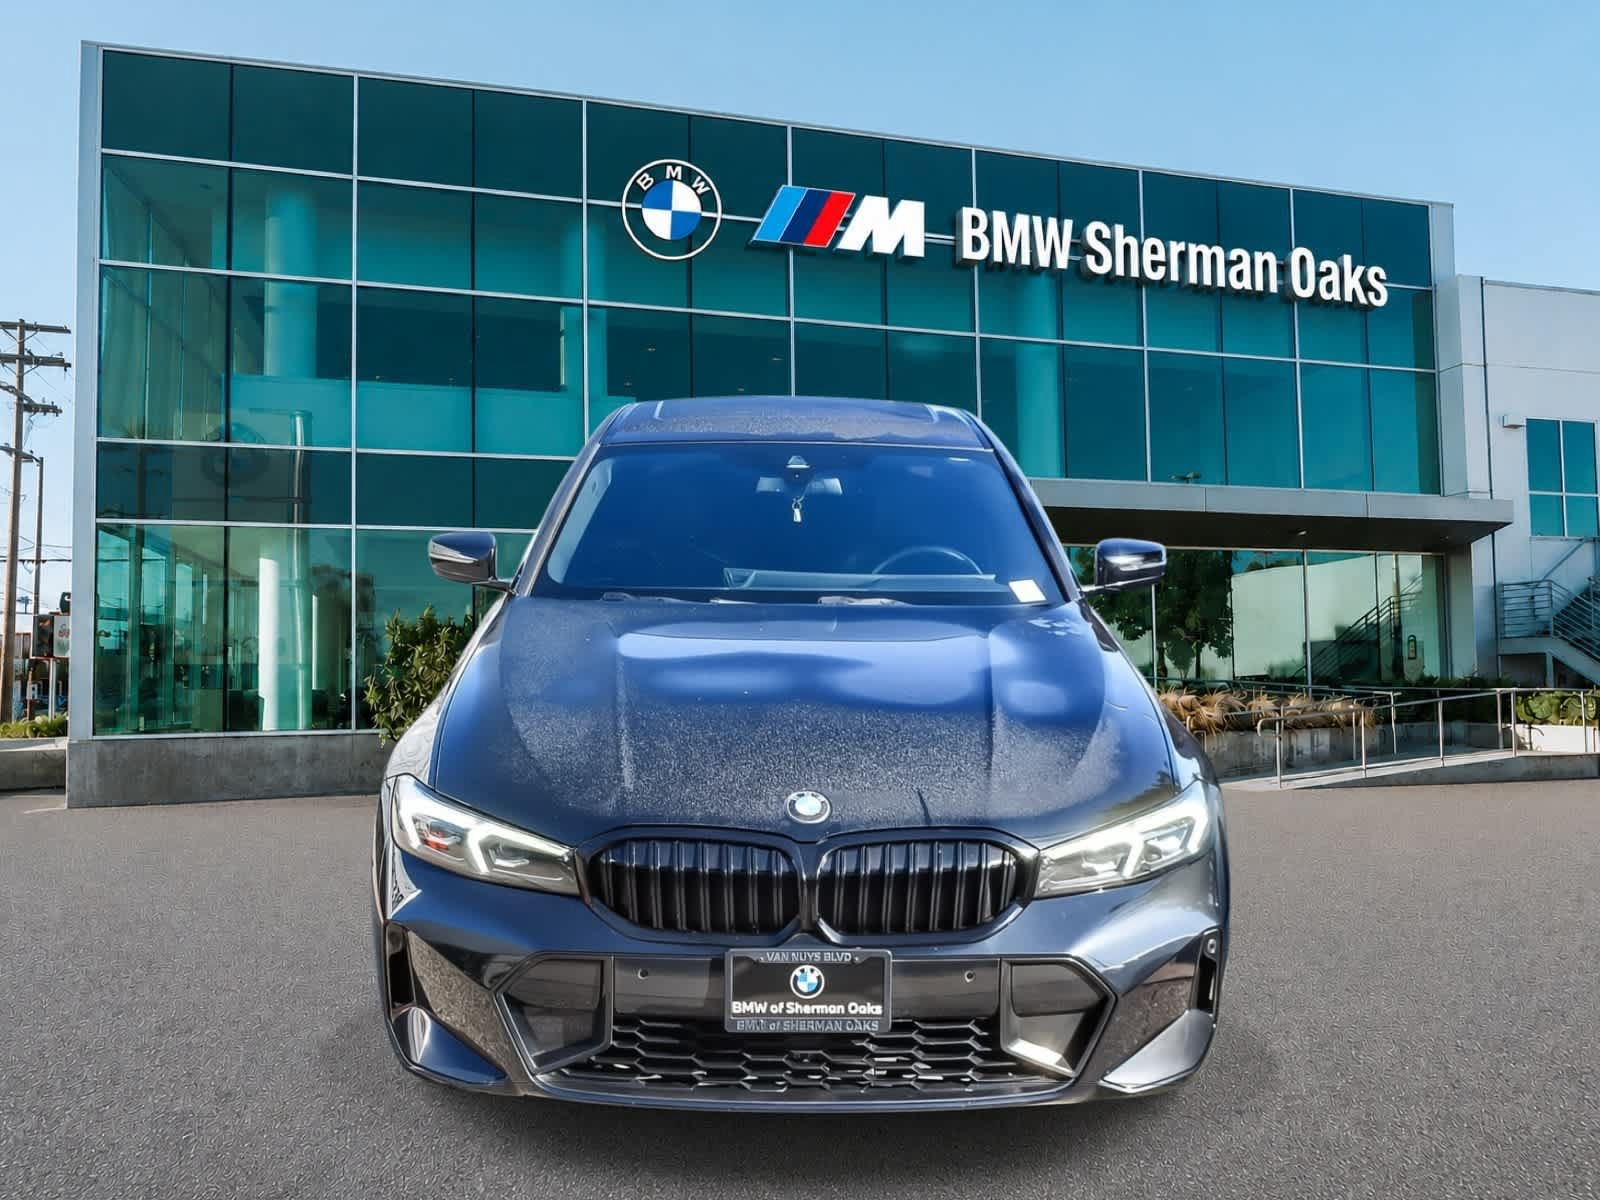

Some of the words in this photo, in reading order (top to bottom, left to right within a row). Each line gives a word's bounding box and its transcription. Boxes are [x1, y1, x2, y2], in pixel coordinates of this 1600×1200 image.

[635, 164, 711, 196] BMW
[834, 195, 925, 257] M
[960, 206, 1073, 270] BMW
[1084, 220, 1278, 294] Sherman
[1289, 247, 1388, 308] Oaks
[766, 952, 789, 962] VAN
[792, 952, 821, 962] NUYS
[823, 952, 852, 962] BLVD
[732, 1001, 767, 1014] BMW
[769, 1002, 784, 1014] of
[786, 1001, 845, 1014] Sherman
[847, 1002, 883, 1015] Oaks
[736, 1020, 767, 1031] BMW
[769, 1021, 780, 1031] of
[783, 1020, 843, 1031] SHERMAN
[846, 1020, 879, 1031] OAKS
